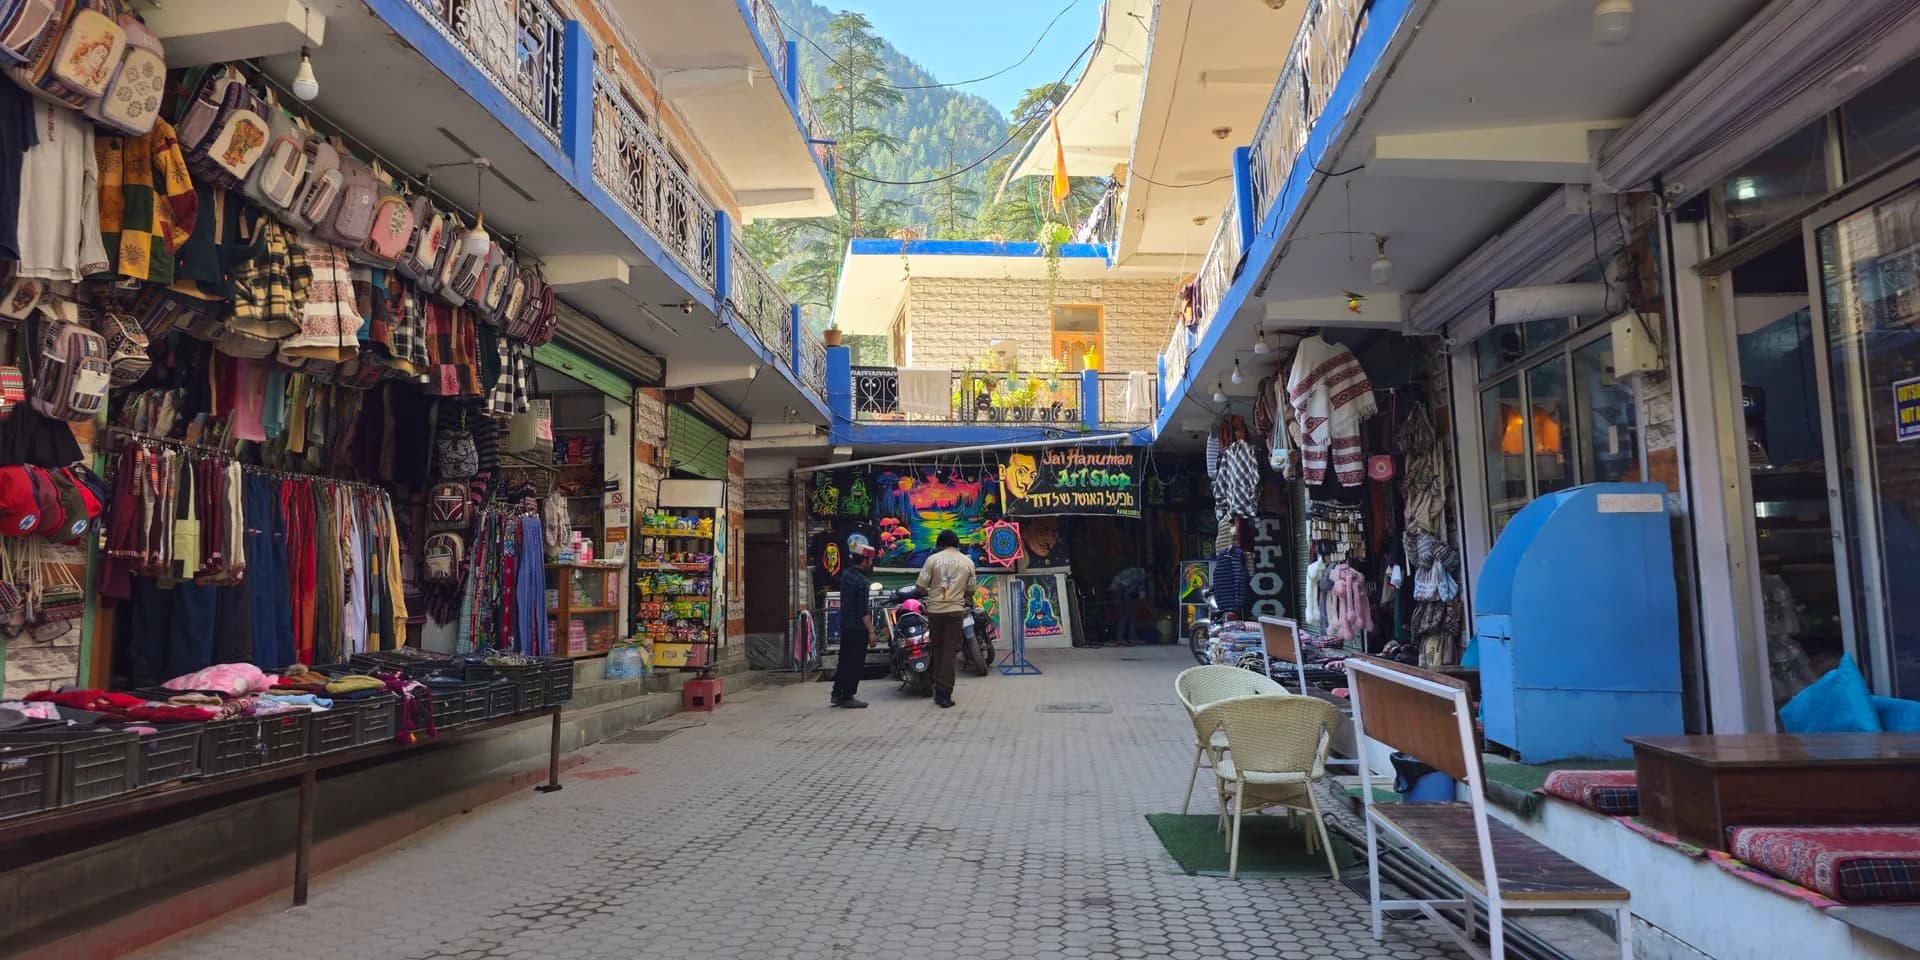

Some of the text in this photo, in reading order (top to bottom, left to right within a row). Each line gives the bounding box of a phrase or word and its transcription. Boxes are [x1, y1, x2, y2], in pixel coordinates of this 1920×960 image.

[1043, 448, 1133, 467] Jai Hanuman
[1055, 468, 1131, 490] Art Shop
[1052, 491, 1070, 507] של
